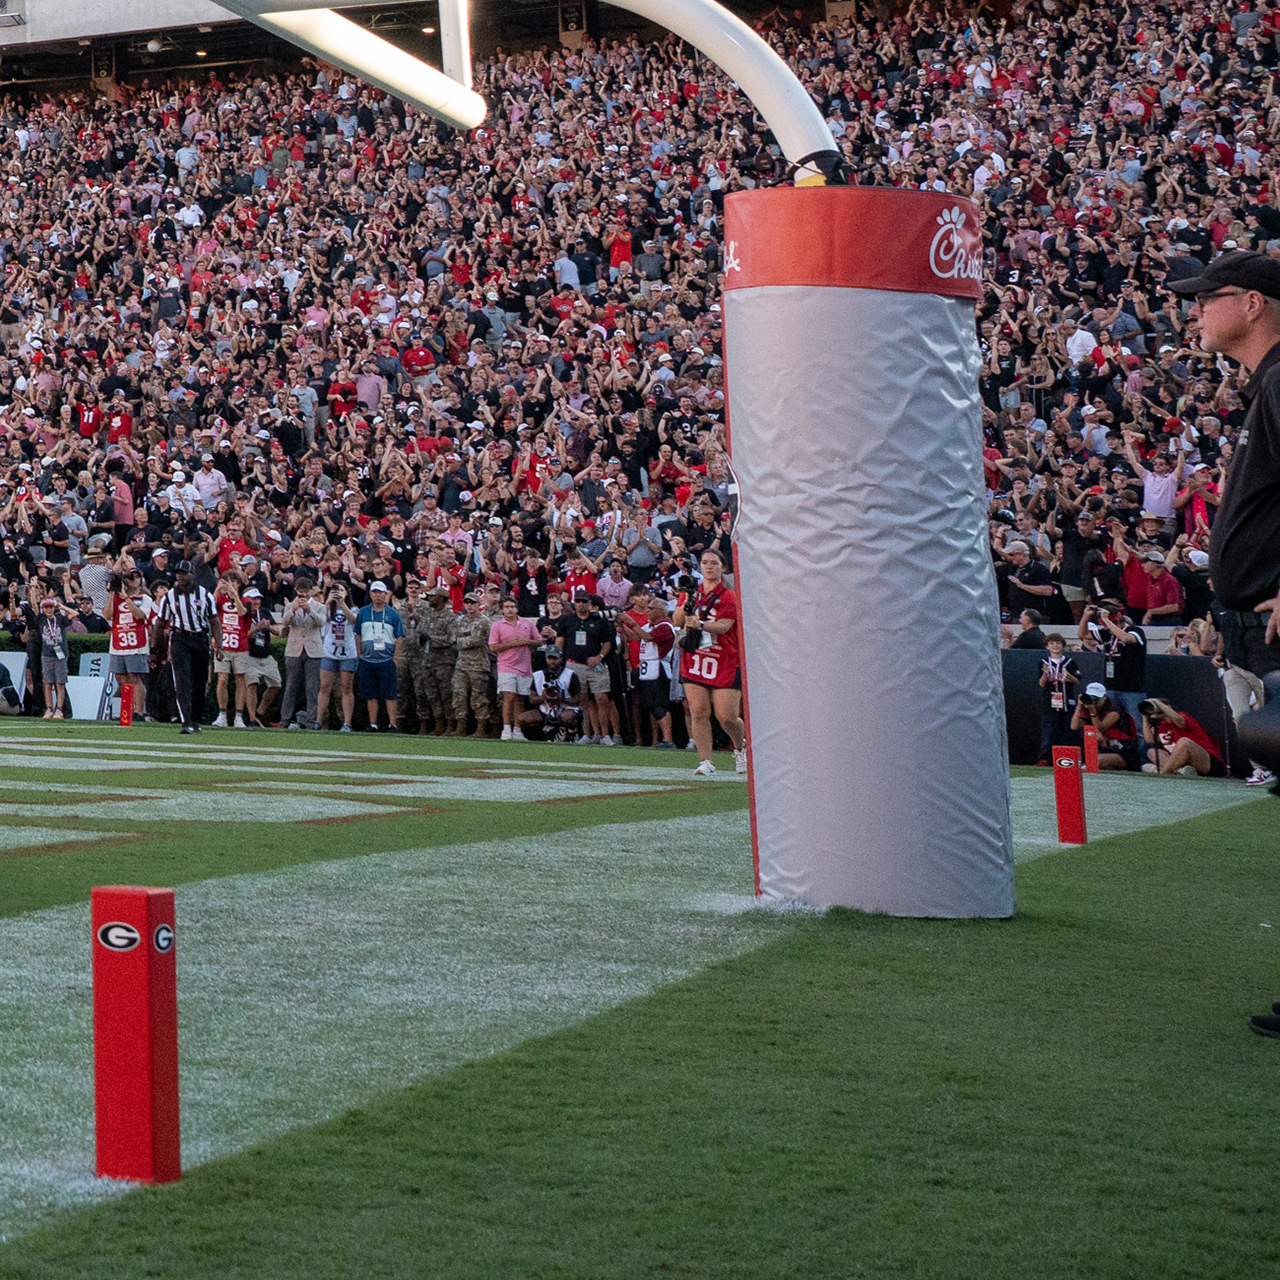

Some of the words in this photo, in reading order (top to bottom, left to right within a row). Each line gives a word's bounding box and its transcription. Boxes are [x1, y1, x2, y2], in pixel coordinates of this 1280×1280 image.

[515, 201, 524, 211] 14
[1009, 270, 1019, 283] 3
[84, 412, 93, 424] 11
[526, 578, 538, 596] 4
[118, 632, 137, 646] 38
[222, 632, 239, 649] 26
[689, 654, 718, 679] 10
[97, 922, 140, 951] G
